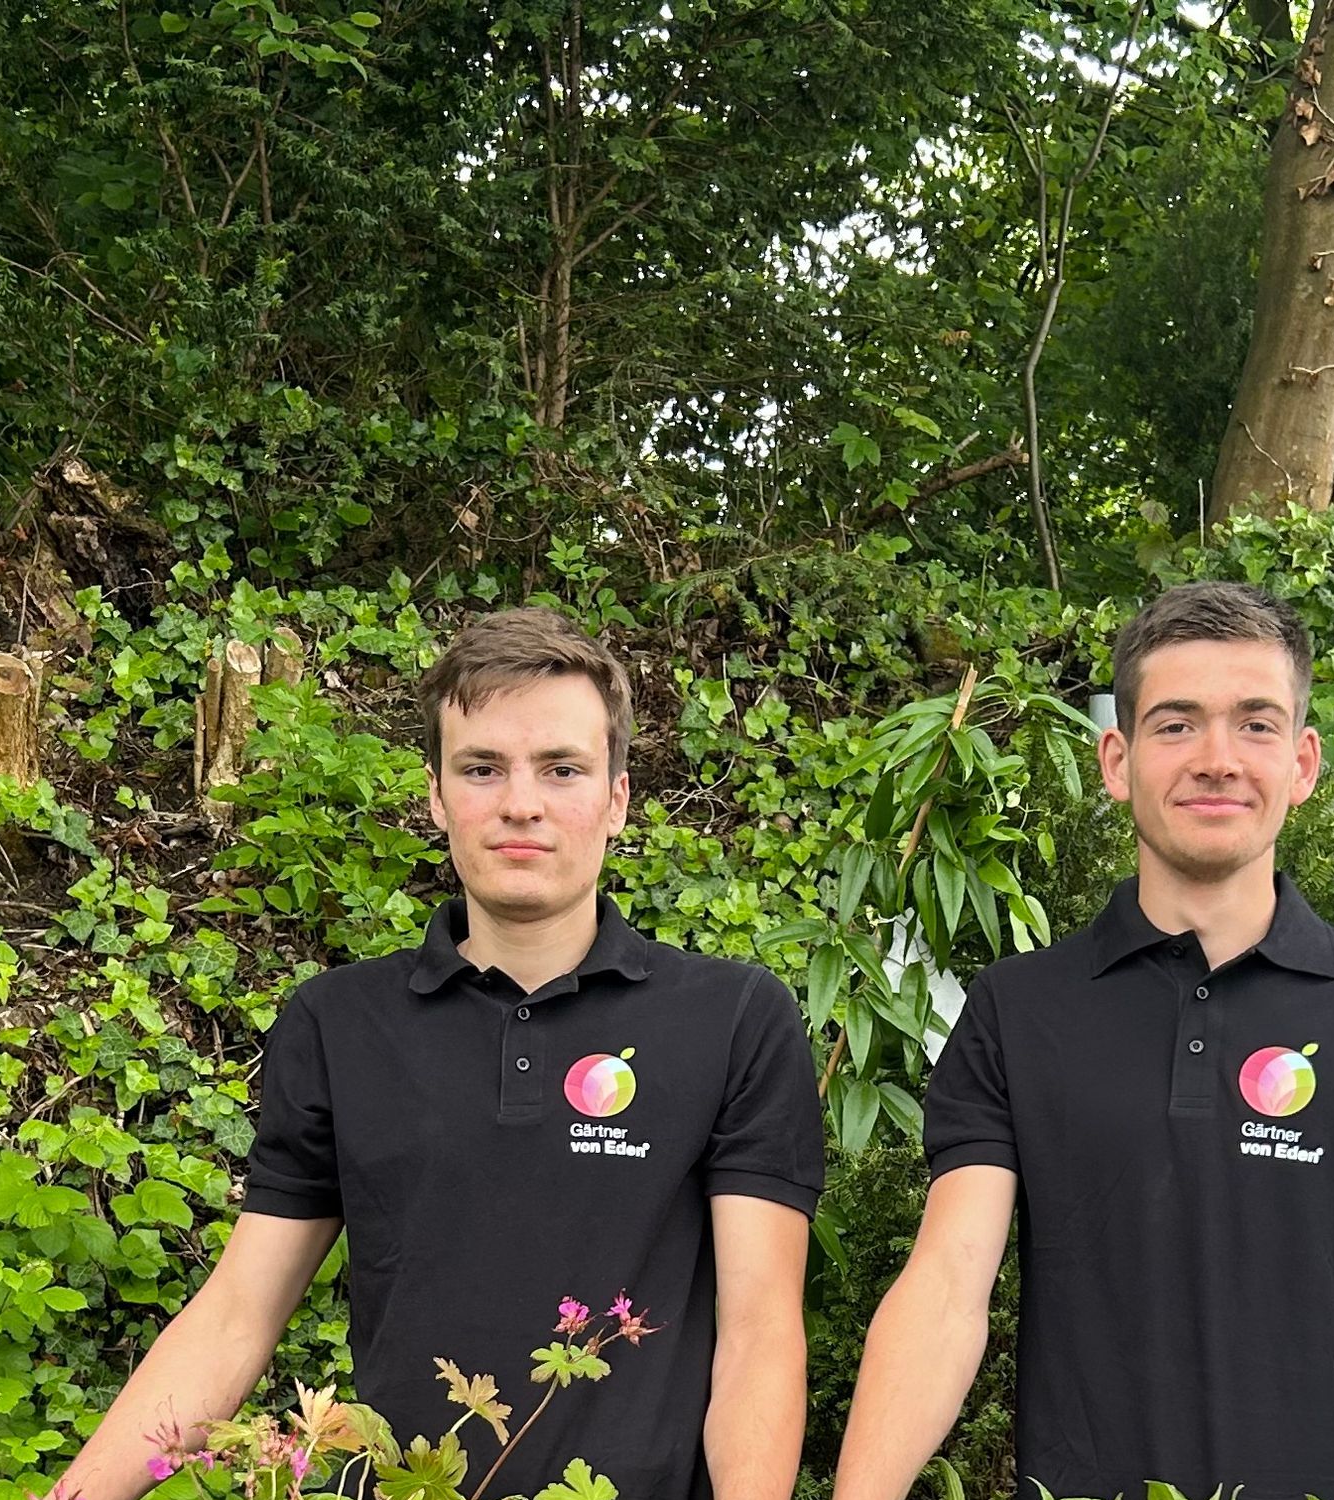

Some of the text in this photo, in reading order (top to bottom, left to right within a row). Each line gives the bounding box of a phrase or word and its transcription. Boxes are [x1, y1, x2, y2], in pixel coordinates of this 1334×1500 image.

[570, 1123, 628, 1139] Gärtner
[1241, 1121, 1302, 1142] Gärtner
[570, 1141, 601, 1153] von
[1240, 1142, 1271, 1157] von
